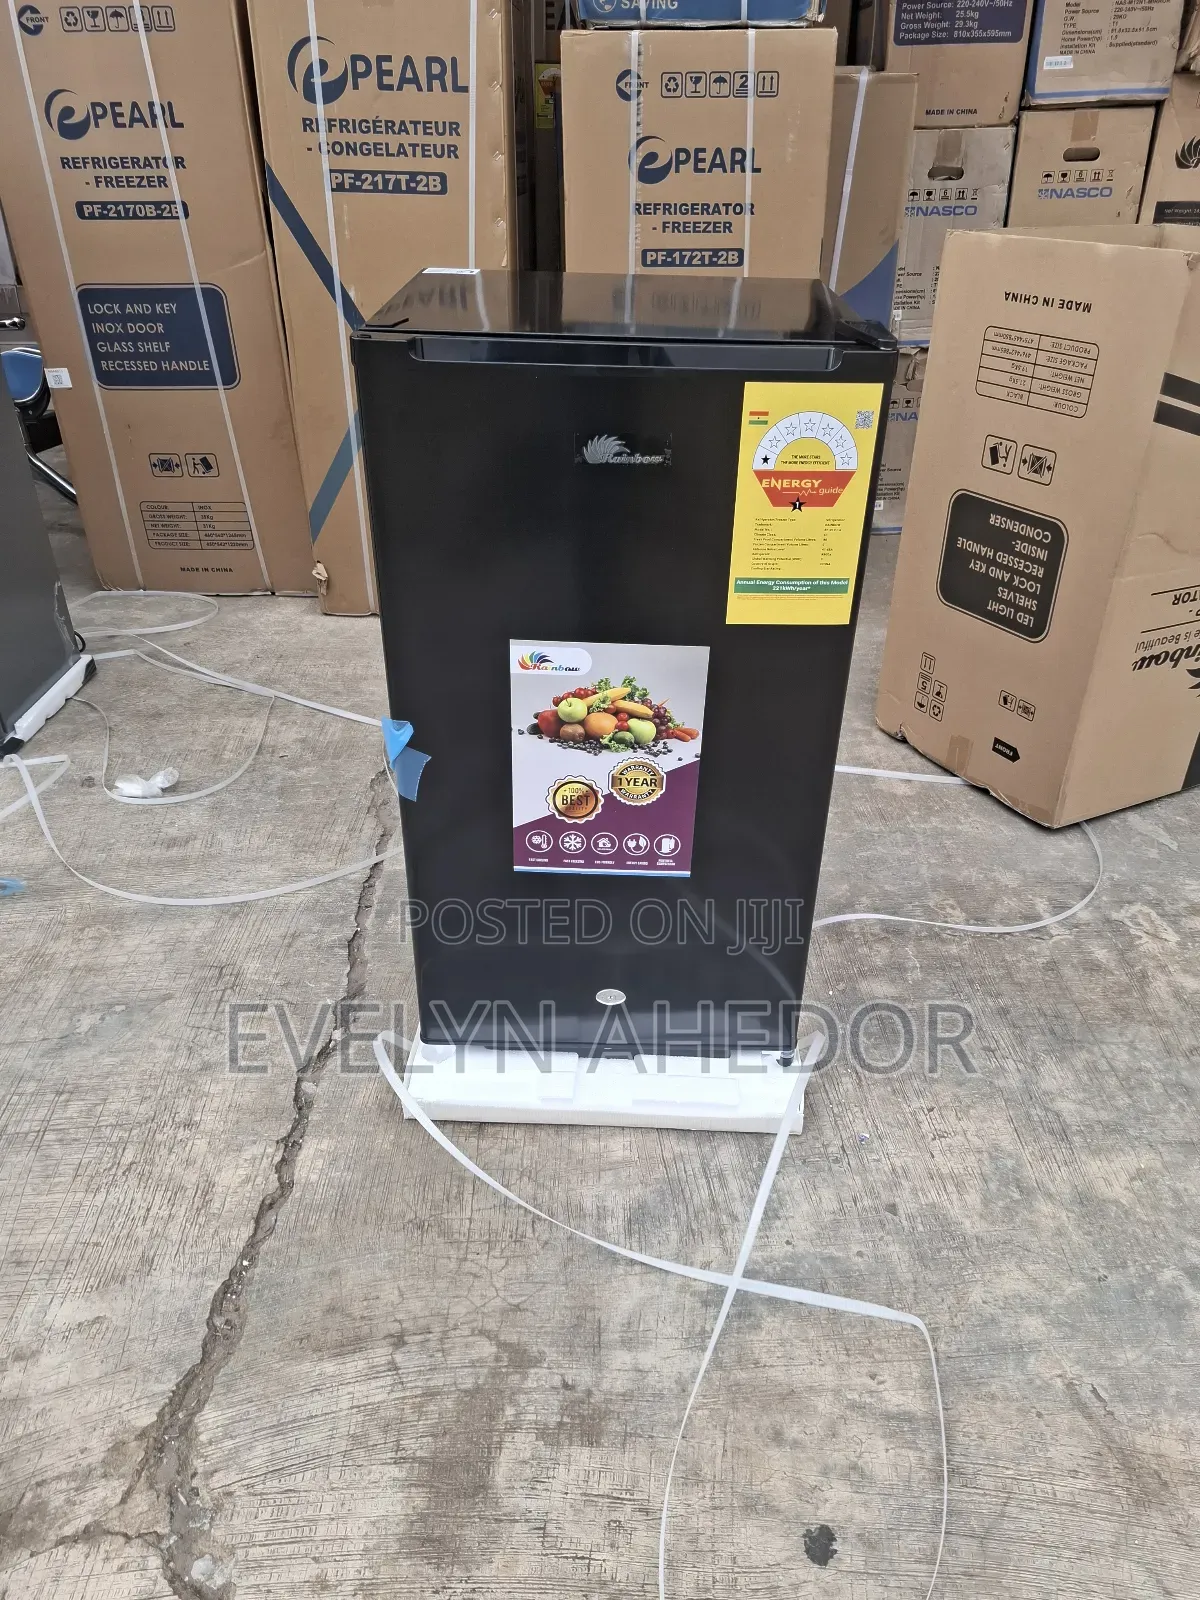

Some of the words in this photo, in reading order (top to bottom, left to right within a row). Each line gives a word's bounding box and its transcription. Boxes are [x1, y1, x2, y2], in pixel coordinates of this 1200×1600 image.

[915, 12, 942, 20] Weight:
[956, 10, 979, 19] 25.5kg
[924, 21, 950, 30] Weight:
[955, 21, 978, 29] 29.3kg
[350, 54, 469, 94] PEARL
[90, 100, 184, 128] PEARL
[60, 156, 187, 170] REFRIGERATOR
[674, 147, 762, 174] PEARL
[94, 175, 169, 188] FREEZER
[331, 172, 442, 192] PF-217T-2B
[1050, 186, 1113, 199] NASCO
[82, 204, 182, 217] PF-2170B-2B
[633, 202, 755, 215] REFRIGERATOR
[914, 205, 978, 217] NASCO
[662, 221, 733, 234] FREEZER
[646, 252, 739, 264] PF-172T-2B
[1004, 291, 1038, 306] CHINA
[1042, 297, 1054, 308] IN
[88, 303, 122, 314] LOCK
[125, 304, 151, 314] AND
[156, 303, 177, 313] KEY
[1058, 299, 1092, 314] MADE
[92, 323, 124, 333] INOX
[128, 323, 164, 334] DOOR
[96, 342, 134, 352] GLASS
[138, 342, 170, 352] SHELF
[100, 360, 158, 371] RECESSED
[162, 360, 210, 370] HANDLE
[762, 477, 822, 490] ENERGY
[819, 487, 844, 496] guide
[989, 513, 1052, 543] CONDENSER
[956, 536, 994, 558] HANDLE
[1012, 540, 1048, 561] INSIDE-
[968, 558, 987, 574] KEY
[996, 550, 1044, 578] RECESSED
[988, 566, 1011, 582] AND
[1012, 577, 1041, 594] LOCK
[998, 587, 1038, 611] SHELVES
[987, 599, 1015, 619] LIGHT
[1017, 611, 1034, 628] LED
[1135, 632, 1182, 653] Beautiful
[1184, 630, 1192, 642] is
[994, 742, 1014, 756] FRONT
[621, 765, 655, 775] WARRANTY
[624, 778, 658, 787] YEAR
[562, 795, 590, 806] BEST
[620, 789, 653, 800] WARRANTY
